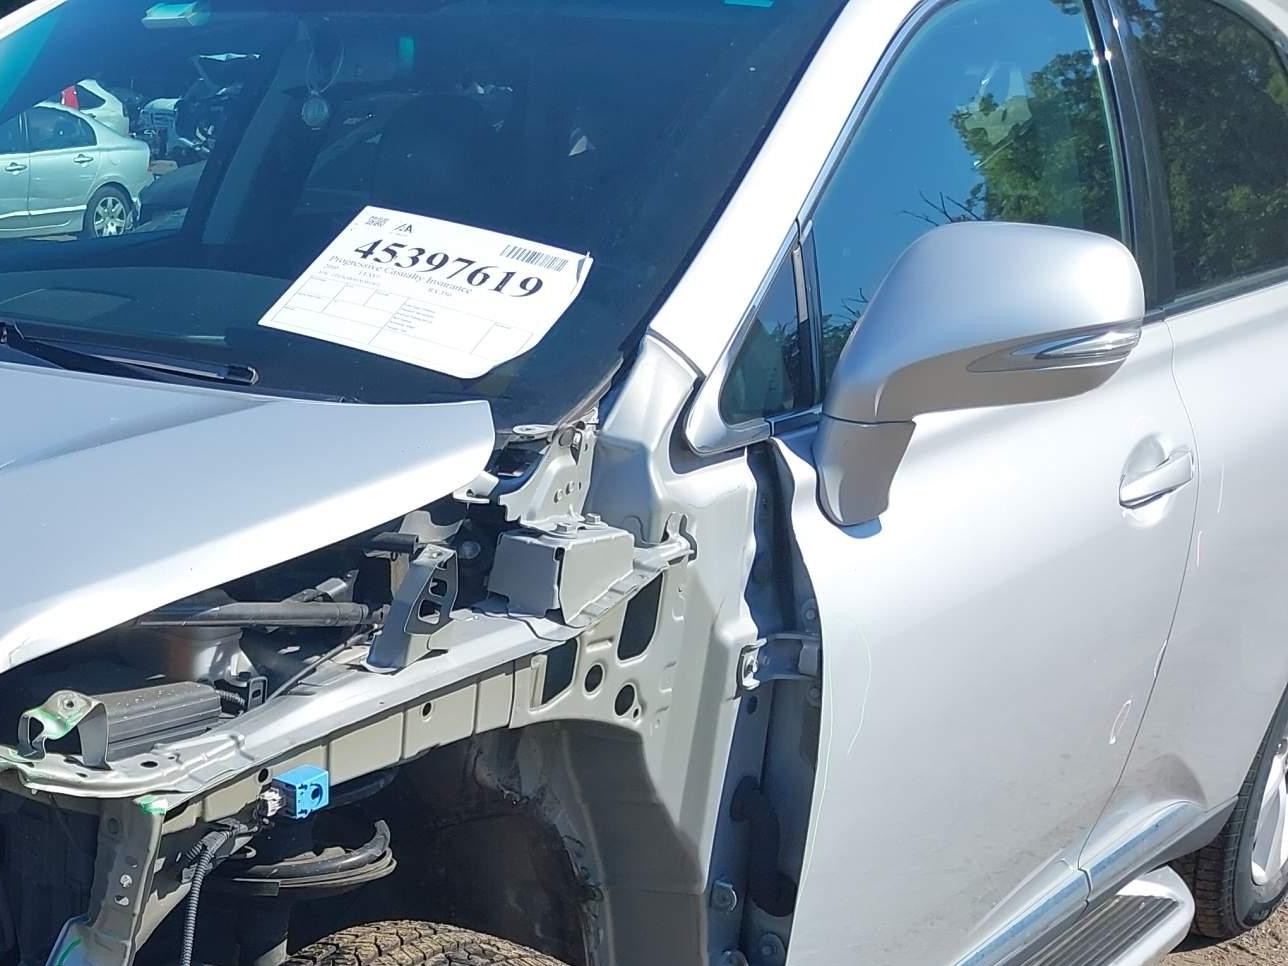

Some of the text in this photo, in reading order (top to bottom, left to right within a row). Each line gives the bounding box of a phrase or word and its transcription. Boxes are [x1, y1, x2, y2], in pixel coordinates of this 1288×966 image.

[329, 255, 383, 271] Progressive
[384, 267, 425, 284] Casualty
[426, 276, 472, 294] Insurance
[353, 239, 544, 297] 45397619
